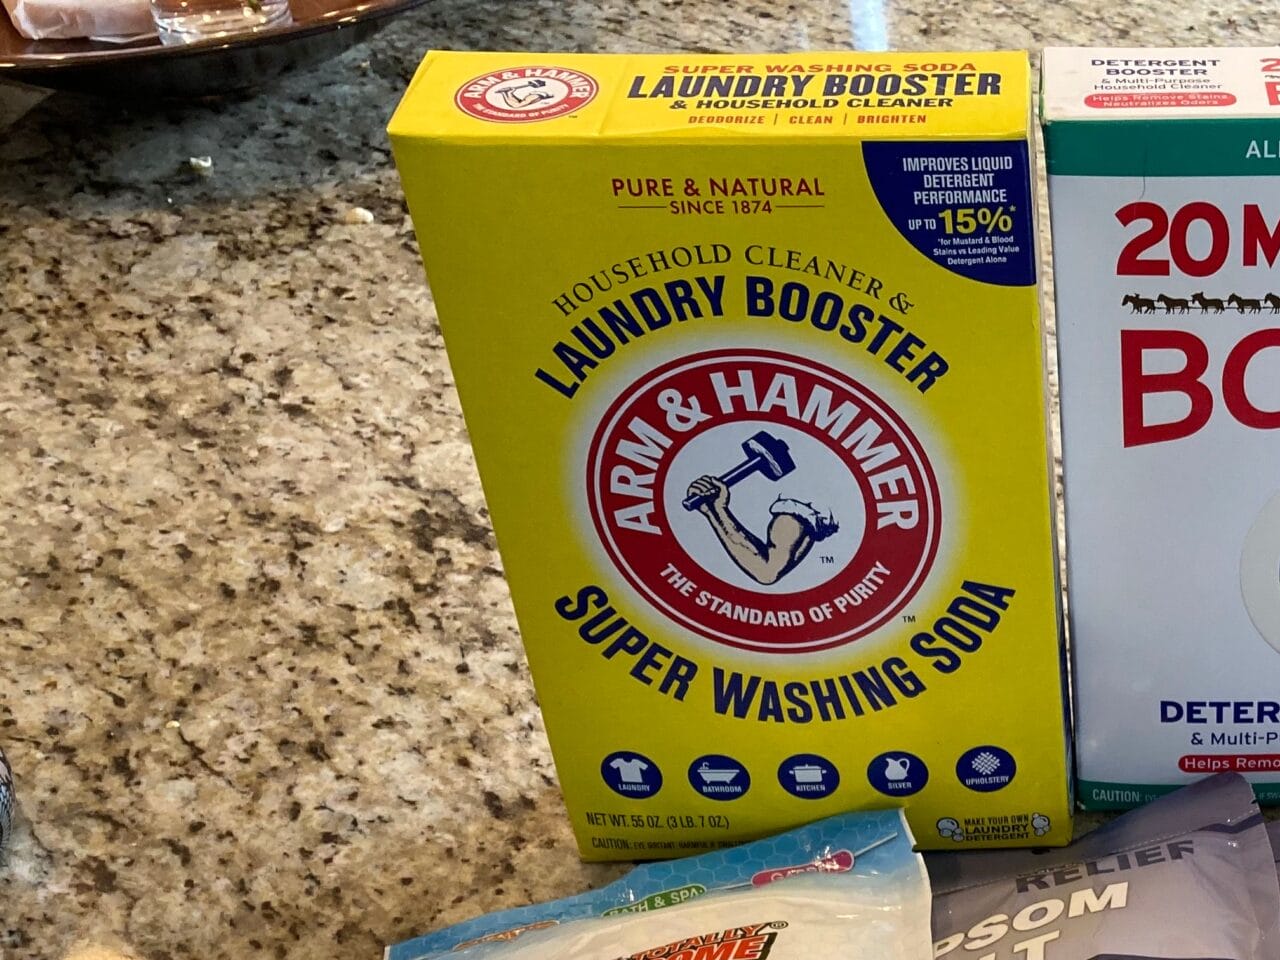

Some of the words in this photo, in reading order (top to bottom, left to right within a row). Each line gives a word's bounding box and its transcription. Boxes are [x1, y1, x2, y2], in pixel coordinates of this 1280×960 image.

[664, 64, 754, 74] SUPER
[765, 63, 892, 73] WASHING
[903, 62, 977, 72] SODA
[1091, 59, 1220, 68] DETERGENT
[1105, 68, 1208, 76] BOOSTER
[627, 74, 815, 99] LAUNDRY
[822, 72, 1002, 97] BOOSTER
[669, 99, 688, 109] &
[697, 98, 840, 109] HOUSEHOLD
[846, 97, 954, 108] CLEANER
[903, 157, 969, 171] IMPROVES
[971, 156, 1013, 171] LIQUID
[612, 179, 675, 197] PURE
[684, 179, 700, 196] &
[709, 177, 826, 197] NATURAL
[923, 173, 995, 188] DETERGENT
[914, 189, 1008, 205] PERFORMANCE
[670, 200, 726, 214] SINCE
[732, 200, 773, 214] 1874
[908, 219, 922, 230] UP
[924, 219, 937, 230] TO
[952, 237, 983, 245] Mustard
[991, 236, 1014, 244] Blood
[1115, 201, 1230, 278] 20
[933, 248, 957, 256] Stains
[968, 246, 998, 255] Leading
[998, 245, 1020, 253] Value
[947, 256, 984, 266] Detergent
[986, 256, 1008, 264] Alone
[551, 243, 732, 317] HOUSEHOLD
[745, 245, 884, 301] CLEANER
[888, 291, 915, 315] &
[535, 274, 726, 400] LAUNDRY
[746, 275, 950, 395] BOOSTER
[609, 416, 664, 537] ARM
[656, 387, 713, 432] &
[709, 369, 921, 531] HAMMER
[554, 584, 699, 702] SUPER
[713, 656, 927, 725] WASHING
[910, 579, 1017, 675] SODA
[1191, 732, 1203, 746] &
[1184, 757, 1230, 771] Helps
[618, 782, 650, 793] LAUNDRY
[796, 784, 826, 792] KITCHEN
[887, 781, 913, 790] SILVER
[965, 775, 1010, 787] UPHOLSTERY
[702, 784, 743, 794] BATHROOM
[586, 811, 607, 826] NET
[609, 814, 629, 828] WT.
[631, 815, 645, 828] 55
[666, 815, 678, 830] (3
[680, 815, 695, 828] LB.
[699, 815, 706, 828] 7
